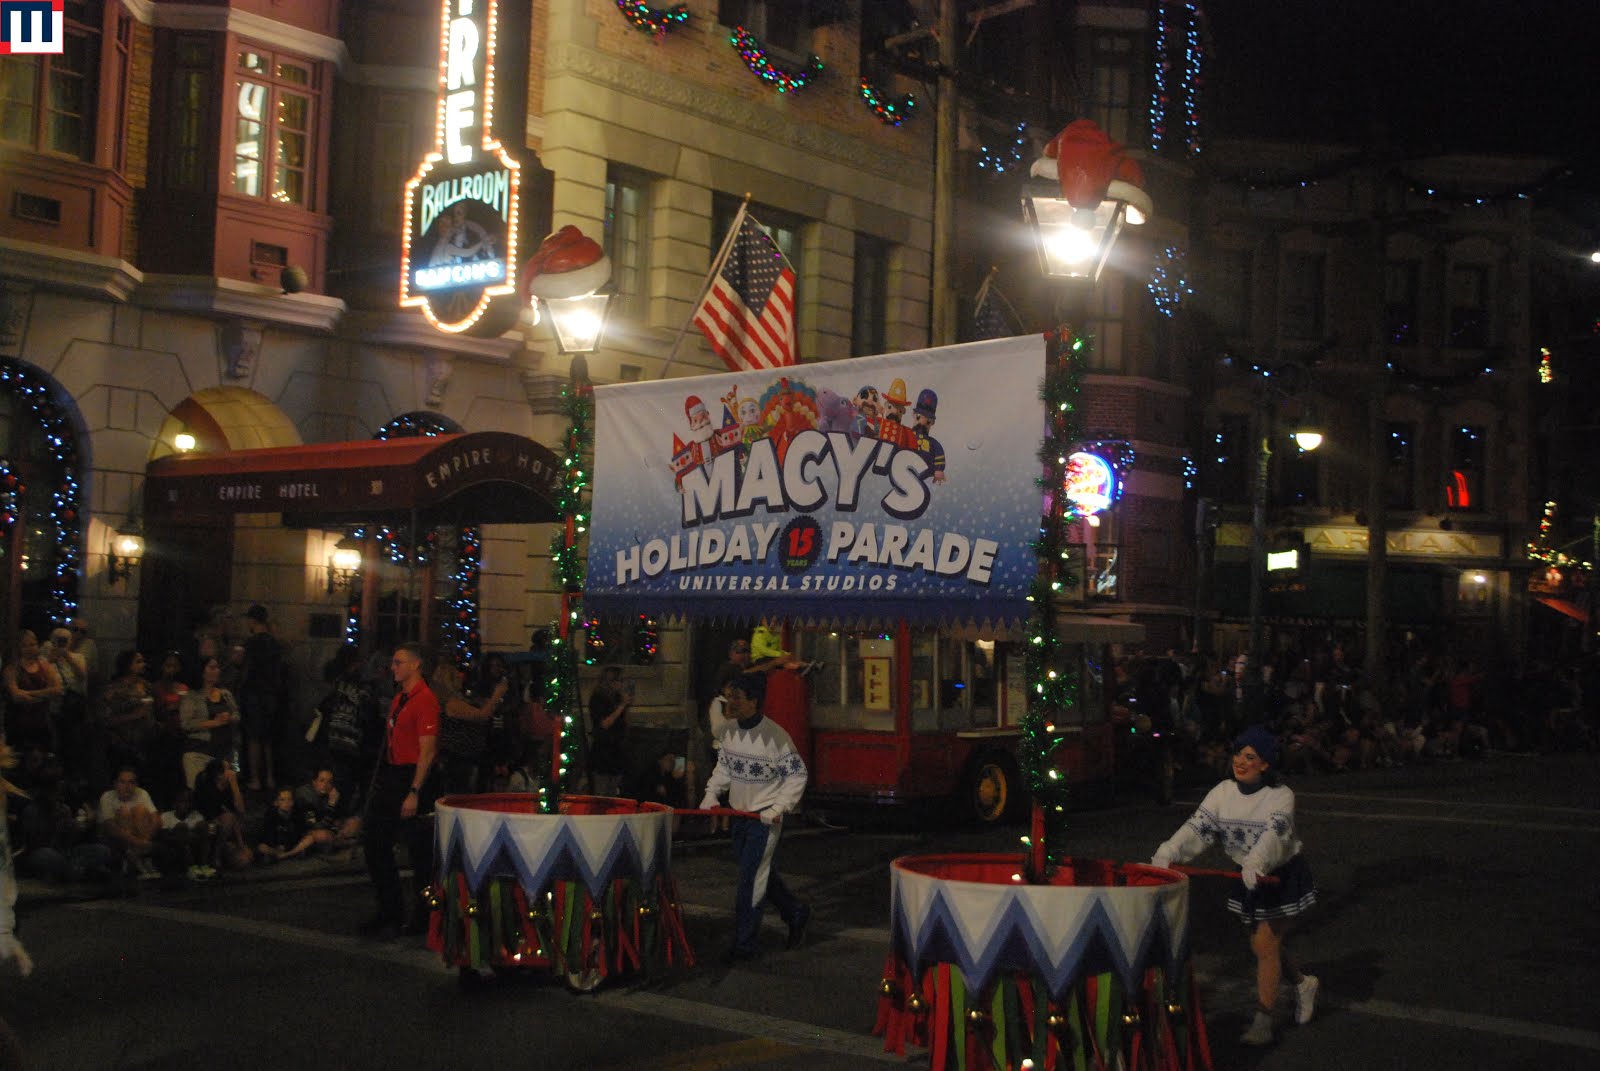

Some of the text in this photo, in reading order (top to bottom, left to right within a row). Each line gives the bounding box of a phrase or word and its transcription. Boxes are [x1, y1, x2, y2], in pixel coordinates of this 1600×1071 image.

[421, 169, 510, 237] BALLROOM
[425, 448, 554, 488] EMPIRE HOT
[681, 429, 931, 526] MACY'S
[219, 482, 320, 501] EMPIRE HOTEL
[616, 521, 999, 586] HOLIDAY PARADE
[788, 527, 815, 557] 15
[678, 574, 899, 591] UNIVERSAL STUDIOS
